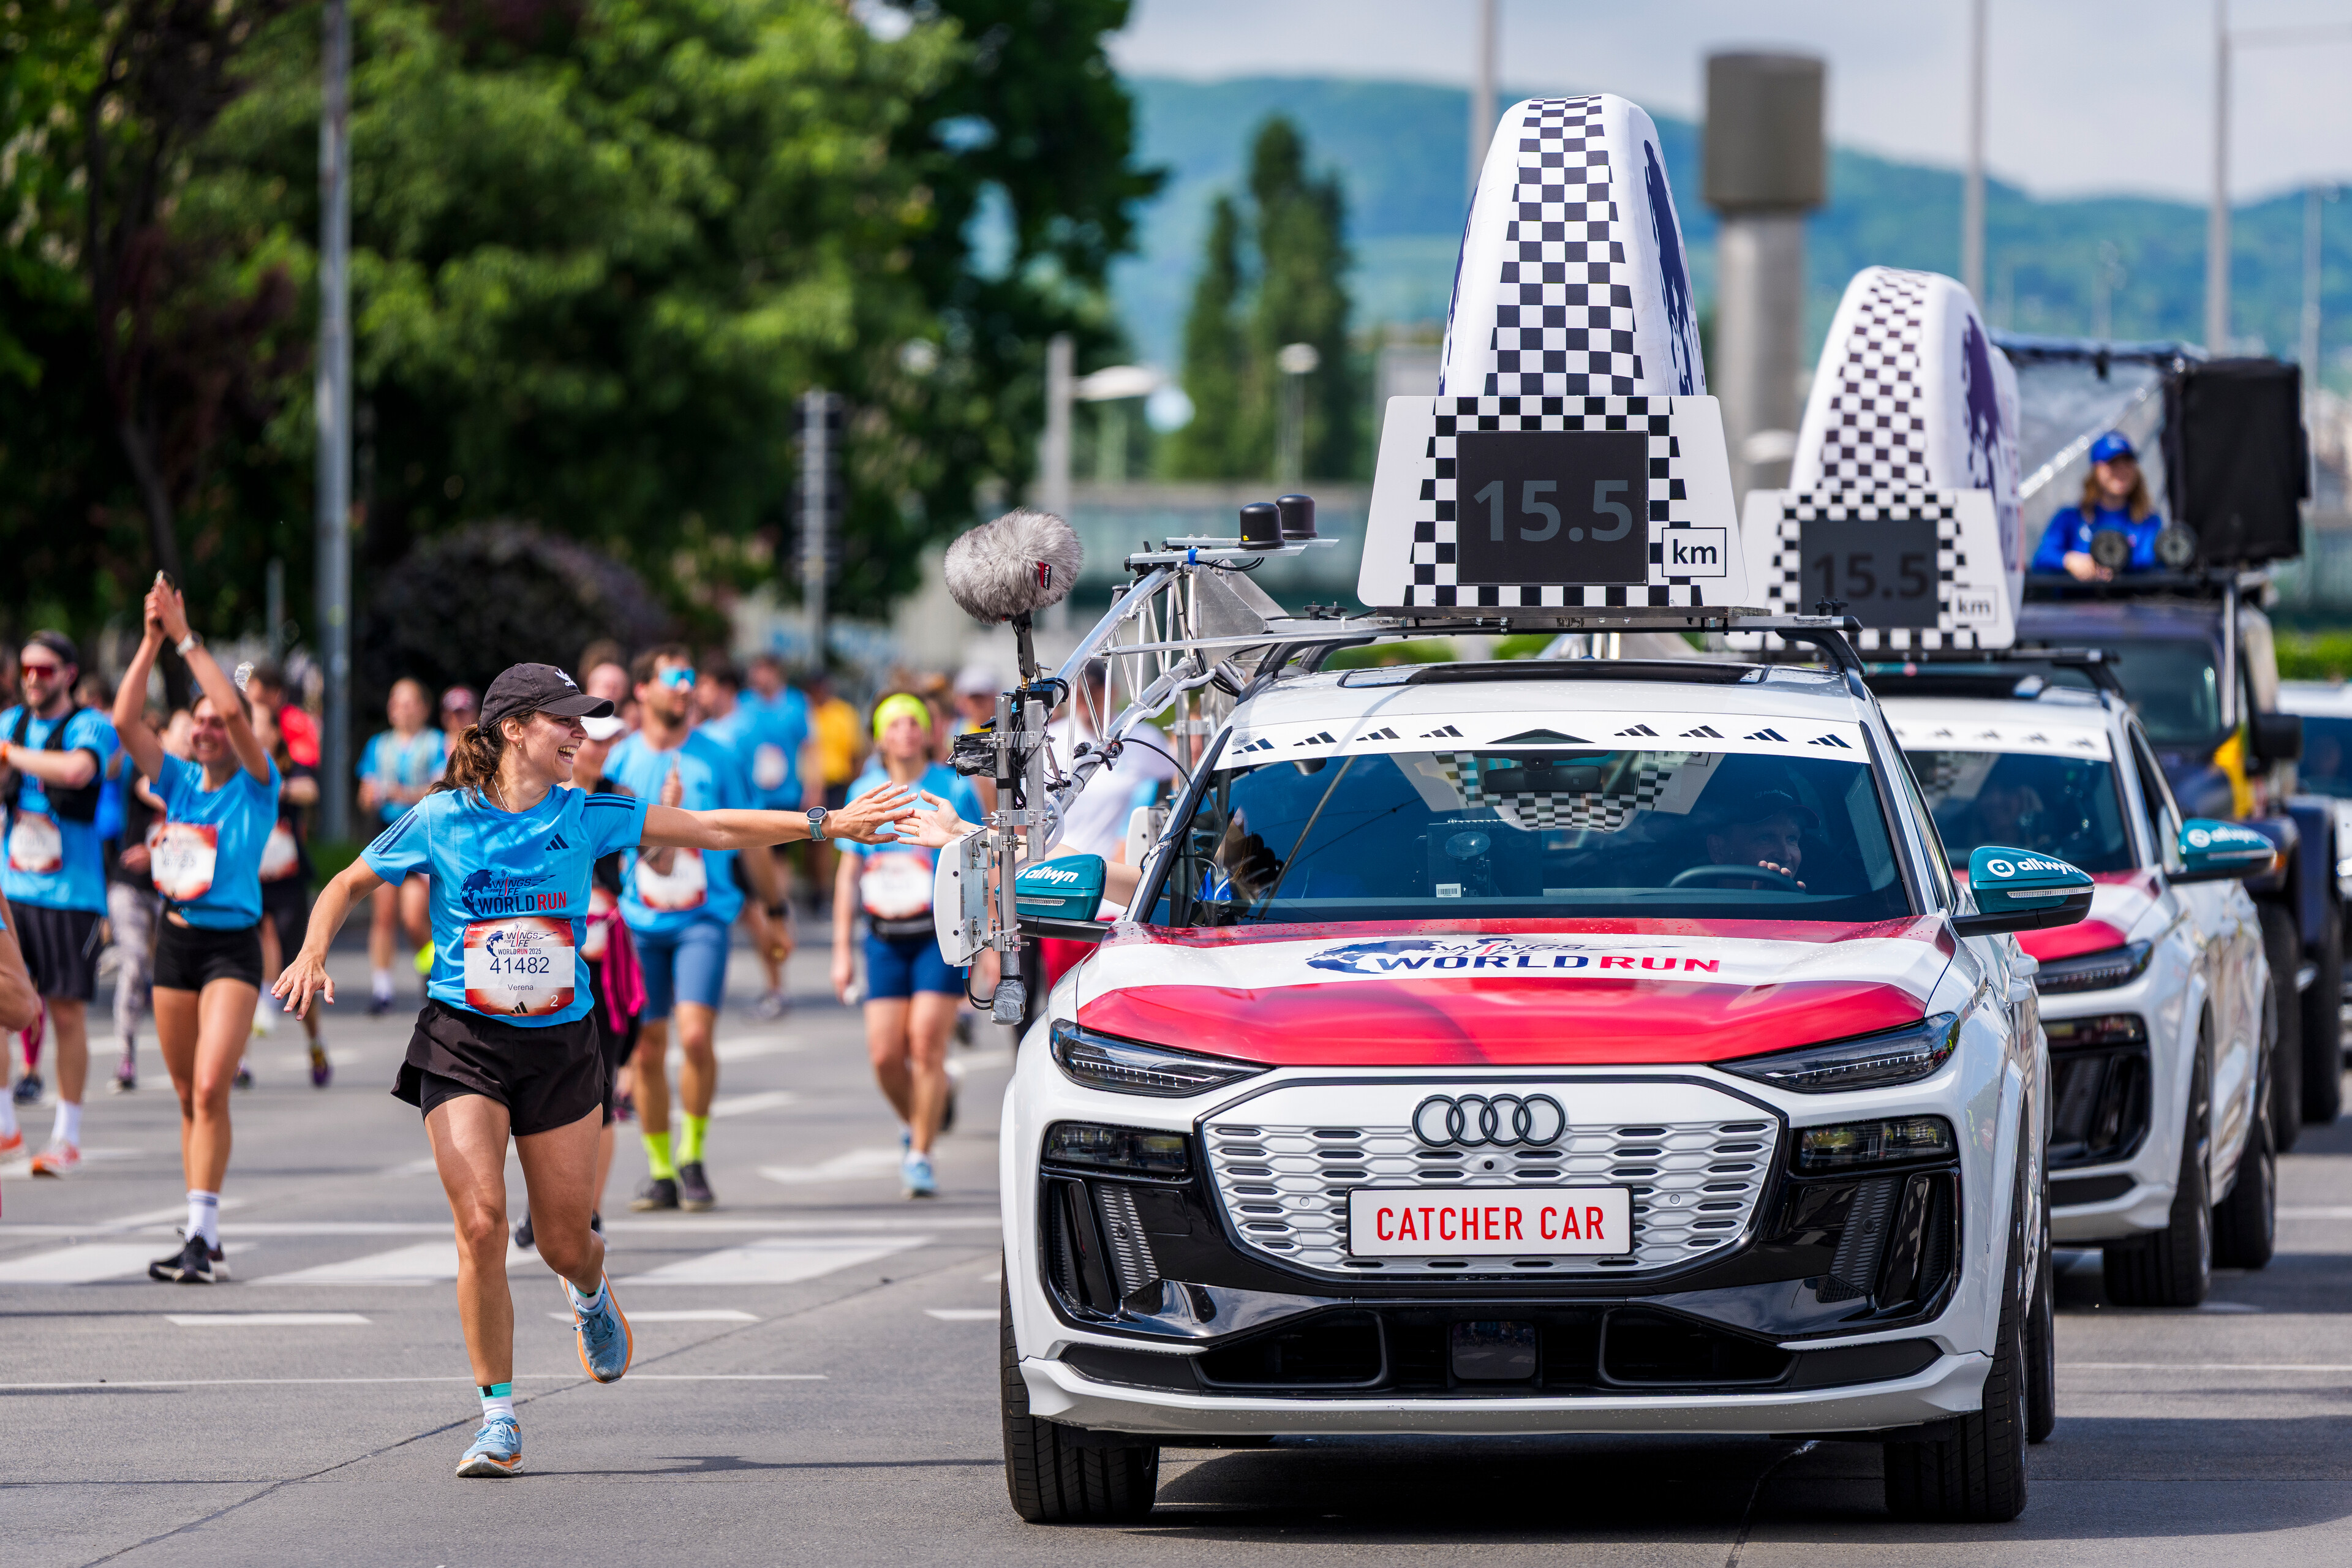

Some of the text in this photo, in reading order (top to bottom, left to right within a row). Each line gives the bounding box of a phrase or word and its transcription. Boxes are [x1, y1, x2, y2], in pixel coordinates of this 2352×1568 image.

[1473, 480, 1633, 542] 15.5
[1673, 538, 1717, 564] km
[1811, 553, 1929, 599] 15.5
[1958, 597, 1991, 616] km
[1025, 866, 1079, 884] allwyn
[2017, 858, 2079, 875] allwyn
[492, 878, 531, 888] WINGS
[498, 888, 521, 896] LIFE
[507, 930, 538, 939] WINGS
[489, 957, 549, 974] 41482
[1374, 956, 1720, 973] WORLD RUN
[550, 995, 559, 1007] 2
[1377, 1206, 1605, 1241] CATCHER CAR
